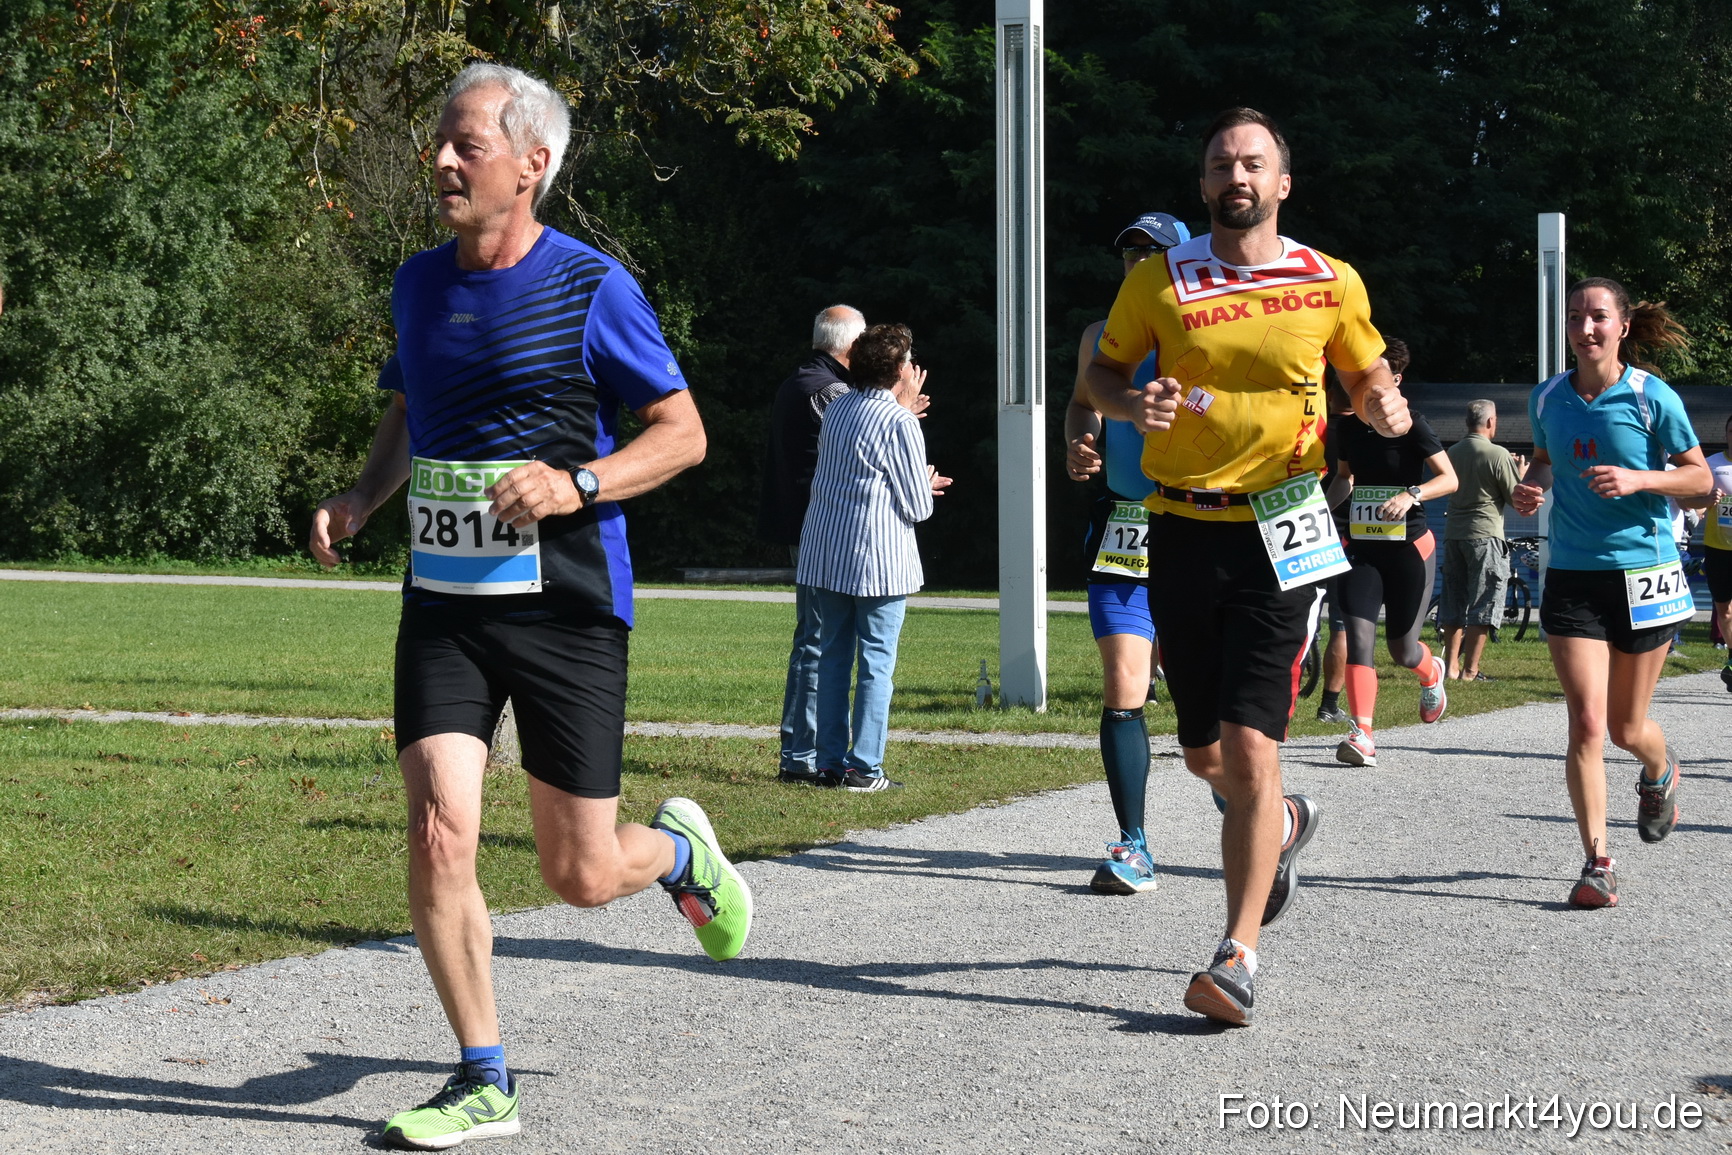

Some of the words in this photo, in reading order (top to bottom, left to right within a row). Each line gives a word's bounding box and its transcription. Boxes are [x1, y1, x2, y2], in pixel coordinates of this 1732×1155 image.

[1181, 301, 1253, 332] MAX
[1261, 290, 1340, 316] BÖGL
[418, 506, 520, 548] 2814
[1656, 599, 1688, 616] JULIA
